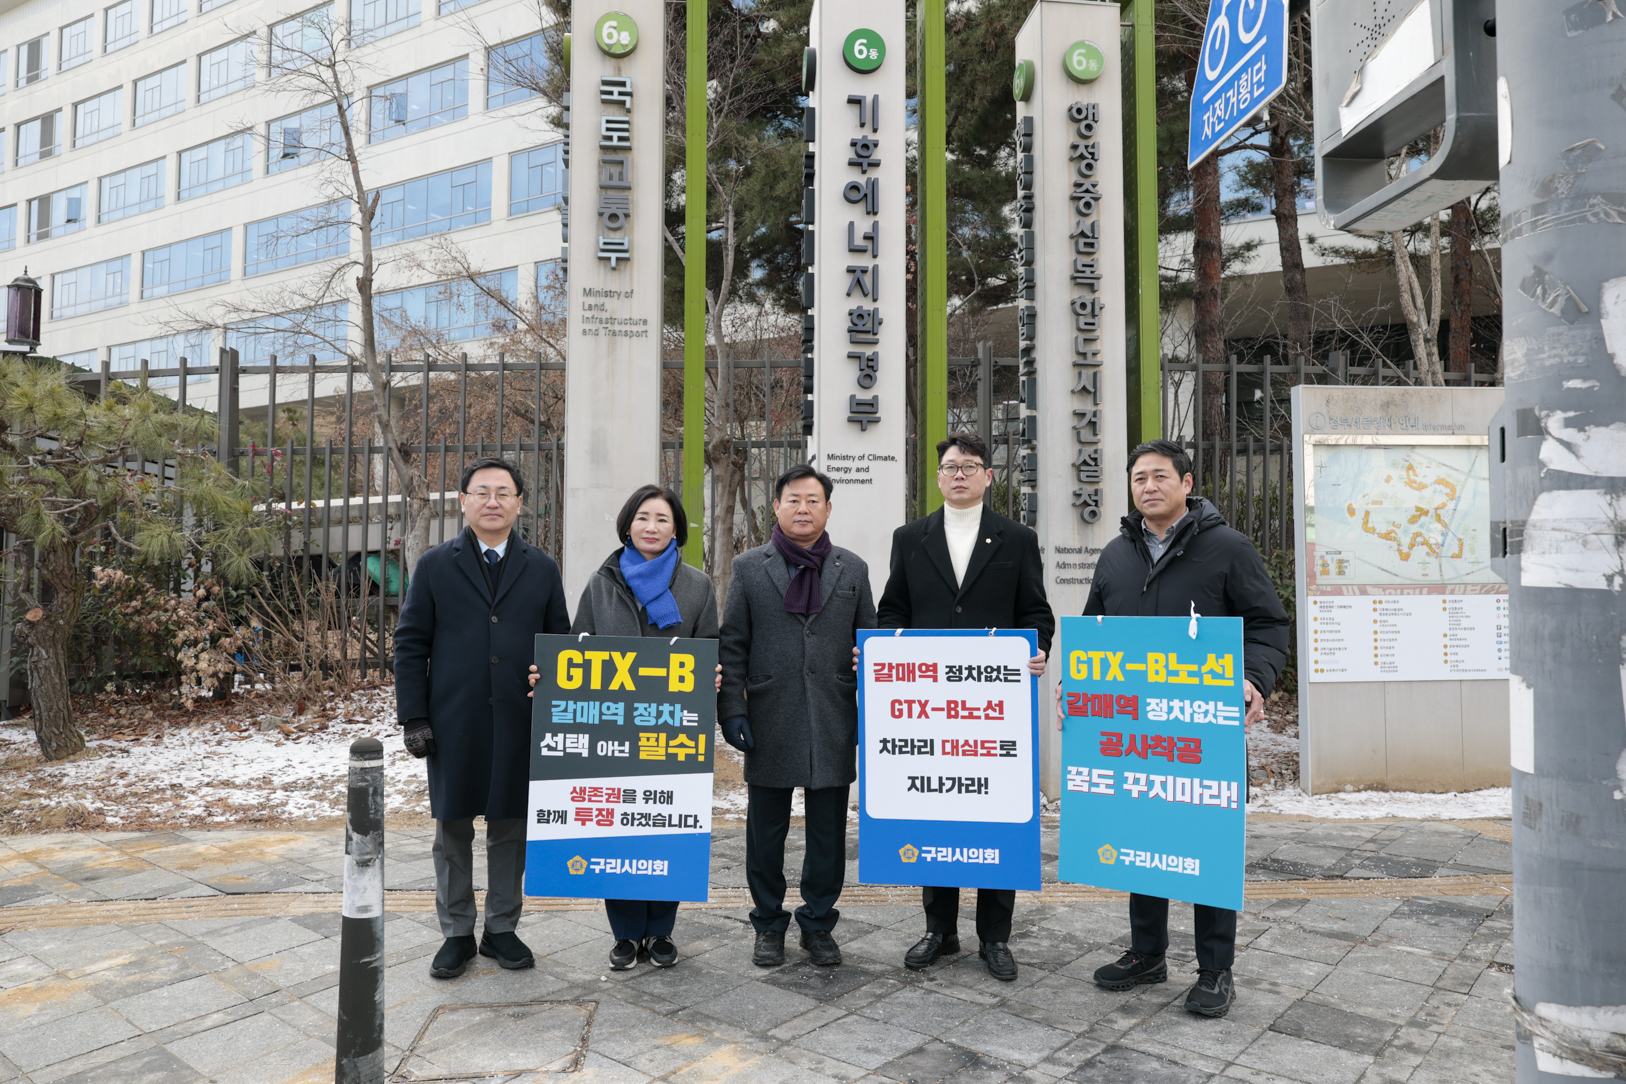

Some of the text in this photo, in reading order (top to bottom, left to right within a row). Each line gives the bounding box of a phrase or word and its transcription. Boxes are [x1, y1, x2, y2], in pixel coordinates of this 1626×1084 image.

[853, 38, 879, 60] 6동
[1072, 48, 1099, 71] 6동
[1201, 54, 1267, 141] 자전거횡단
[598, 76, 633, 271] 국토교통부
[843, 94, 884, 431] 기후에너지환경부
[582, 287, 634, 300] Ministry of
[582, 301, 608, 313] Land,
[1068, 101, 1105, 524] 행정중심복합도시건설청
[581, 314, 648, 326] Infrastructure
[581, 326, 649, 339] and Transport
[1399, 415, 1421, 431] 안내
[827, 453, 897, 462] Ministry of Climate,
[826, 464, 870, 474] Energy and
[1055, 545, 1083, 554] National
[1084, 546, 1103, 556] Agen
[556, 649, 695, 693] GTX-B
[873, 662, 1021, 683] 갈매역 정차없는
[1069, 650, 1235, 686] GTX-B노선
[551, 700, 699, 727] 갈매역 정차는
[890, 699, 1005, 721] GTX-B노선
[1066, 691, 1240, 726] 갈매역 정차없는
[540, 732, 706, 762] 선택 아닌 필수!
[879, 738, 1018, 758] 차라리 대심도로
[1099, 731, 1203, 765] 공사착공
[570, 786, 674, 805] 생존권을 위해
[907, 775, 989, 795] 지나가라!
[1066, 765, 1239, 810] 꿈도 꾸지마라!
[536, 807, 703, 829] 함께 투쟁 하겠습니다.
[921, 846, 1000, 865] 구리시의회
[1119, 848, 1200, 876] 구리시의회
[590, 858, 669, 876] 구리시의회
